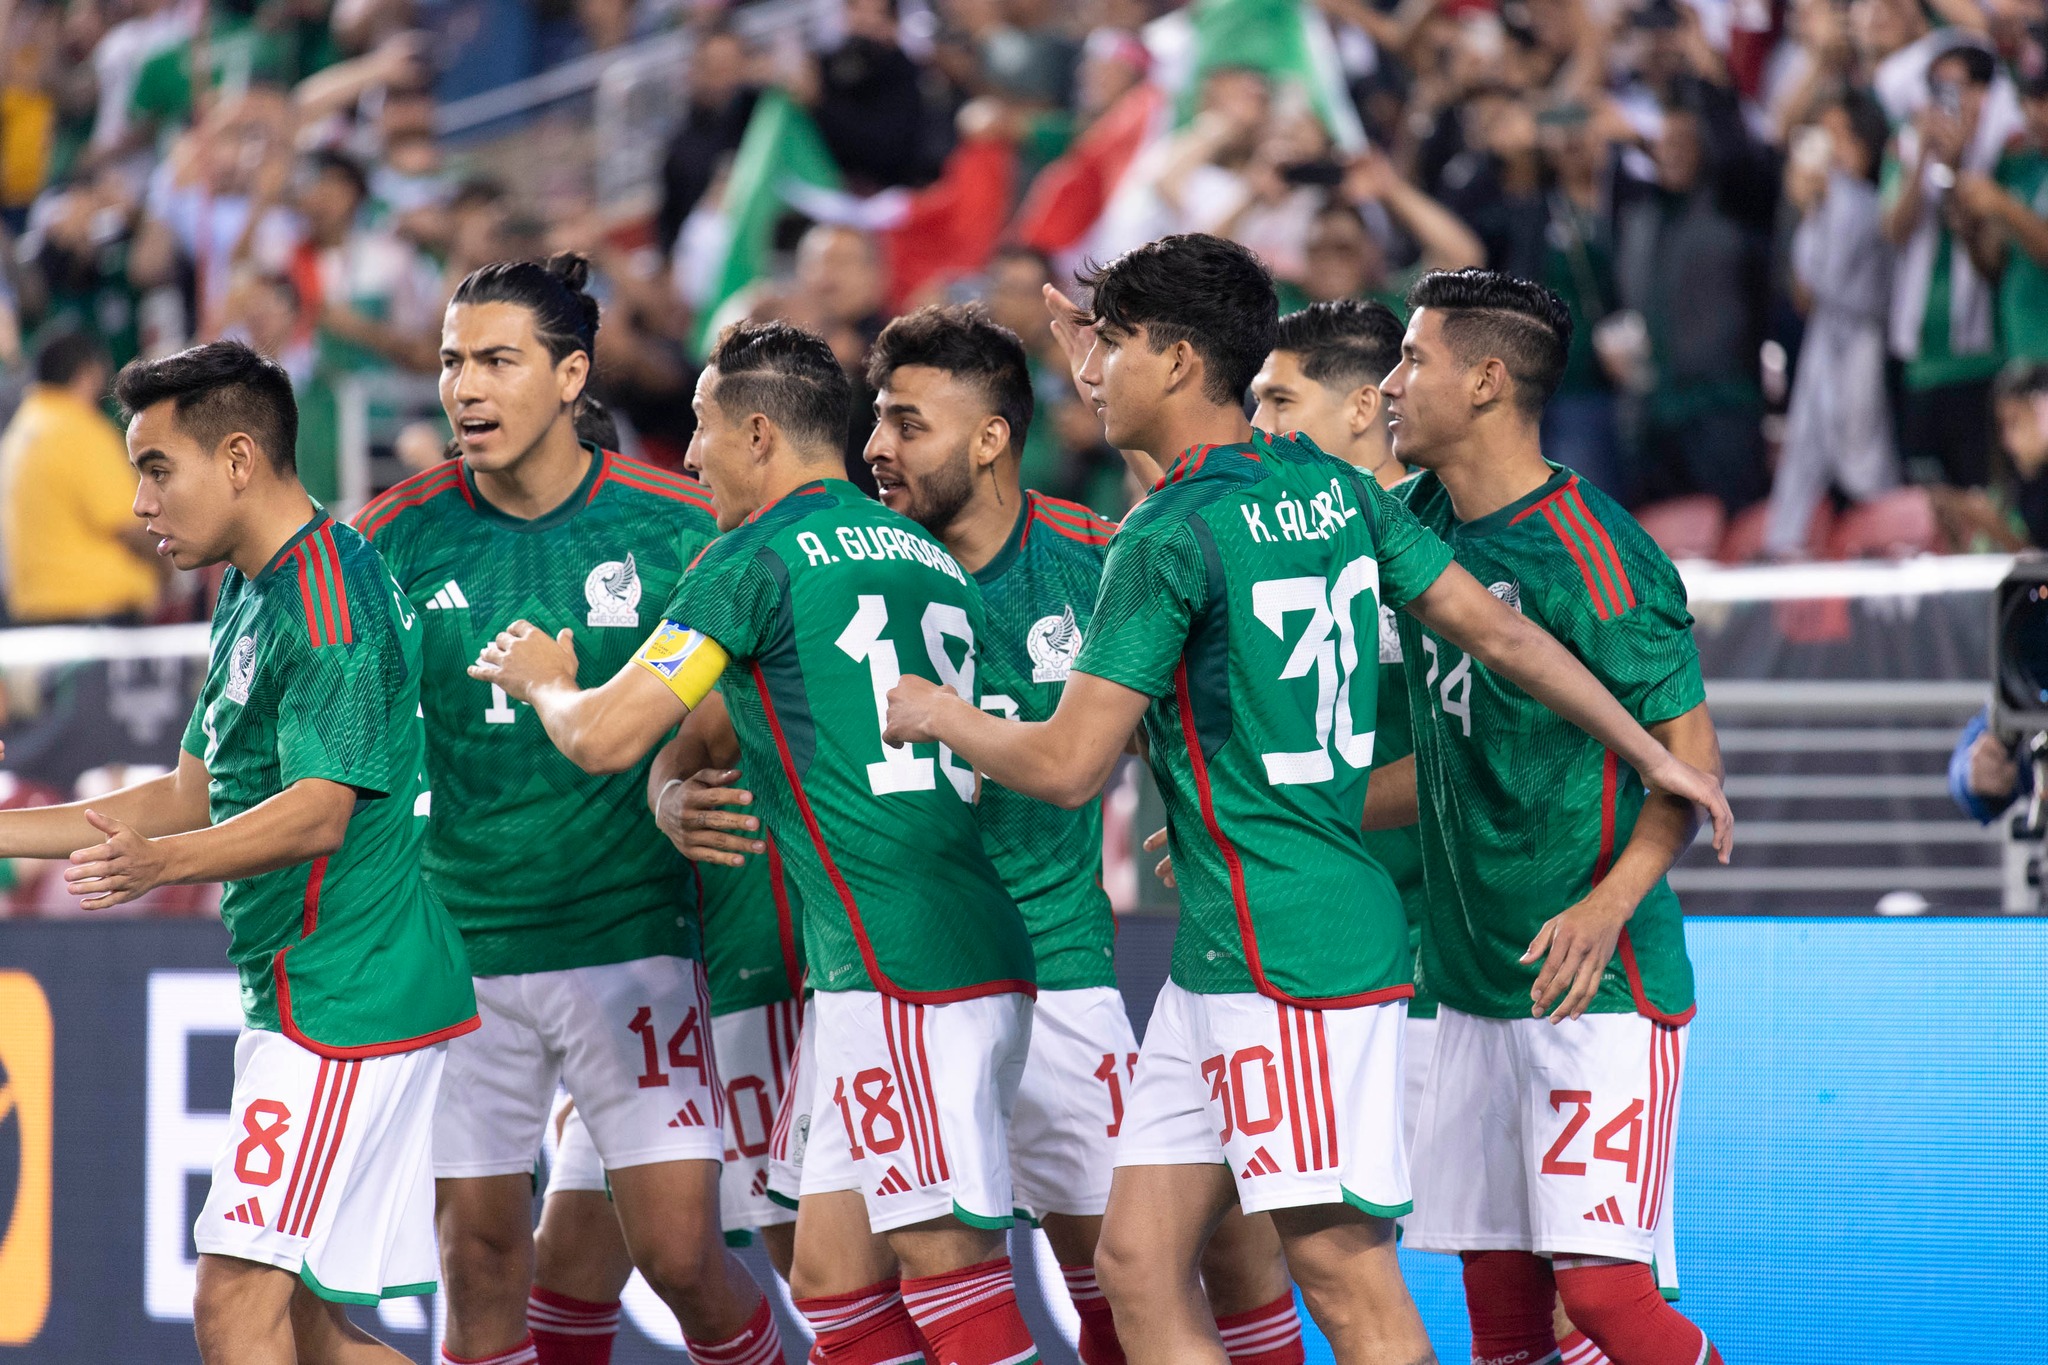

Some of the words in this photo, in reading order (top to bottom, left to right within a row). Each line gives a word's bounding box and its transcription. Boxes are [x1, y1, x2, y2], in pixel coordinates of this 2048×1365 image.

[796, 531, 841, 567] A.
[835, 526, 967, 587] GUARDADO
[1240, 503, 1279, 543] K.
[589, 612, 637, 624] MÉXICO
[1036, 668, 1071, 681] MÉXIC
[1251, 554, 1381, 786] 30
[627, 1005, 708, 1089] 14
[833, 1066, 906, 1162] 18
[1200, 1044, 1284, 1147] 30
[1540, 1089, 1645, 1184] 24
[234, 1098, 292, 1188] 8
